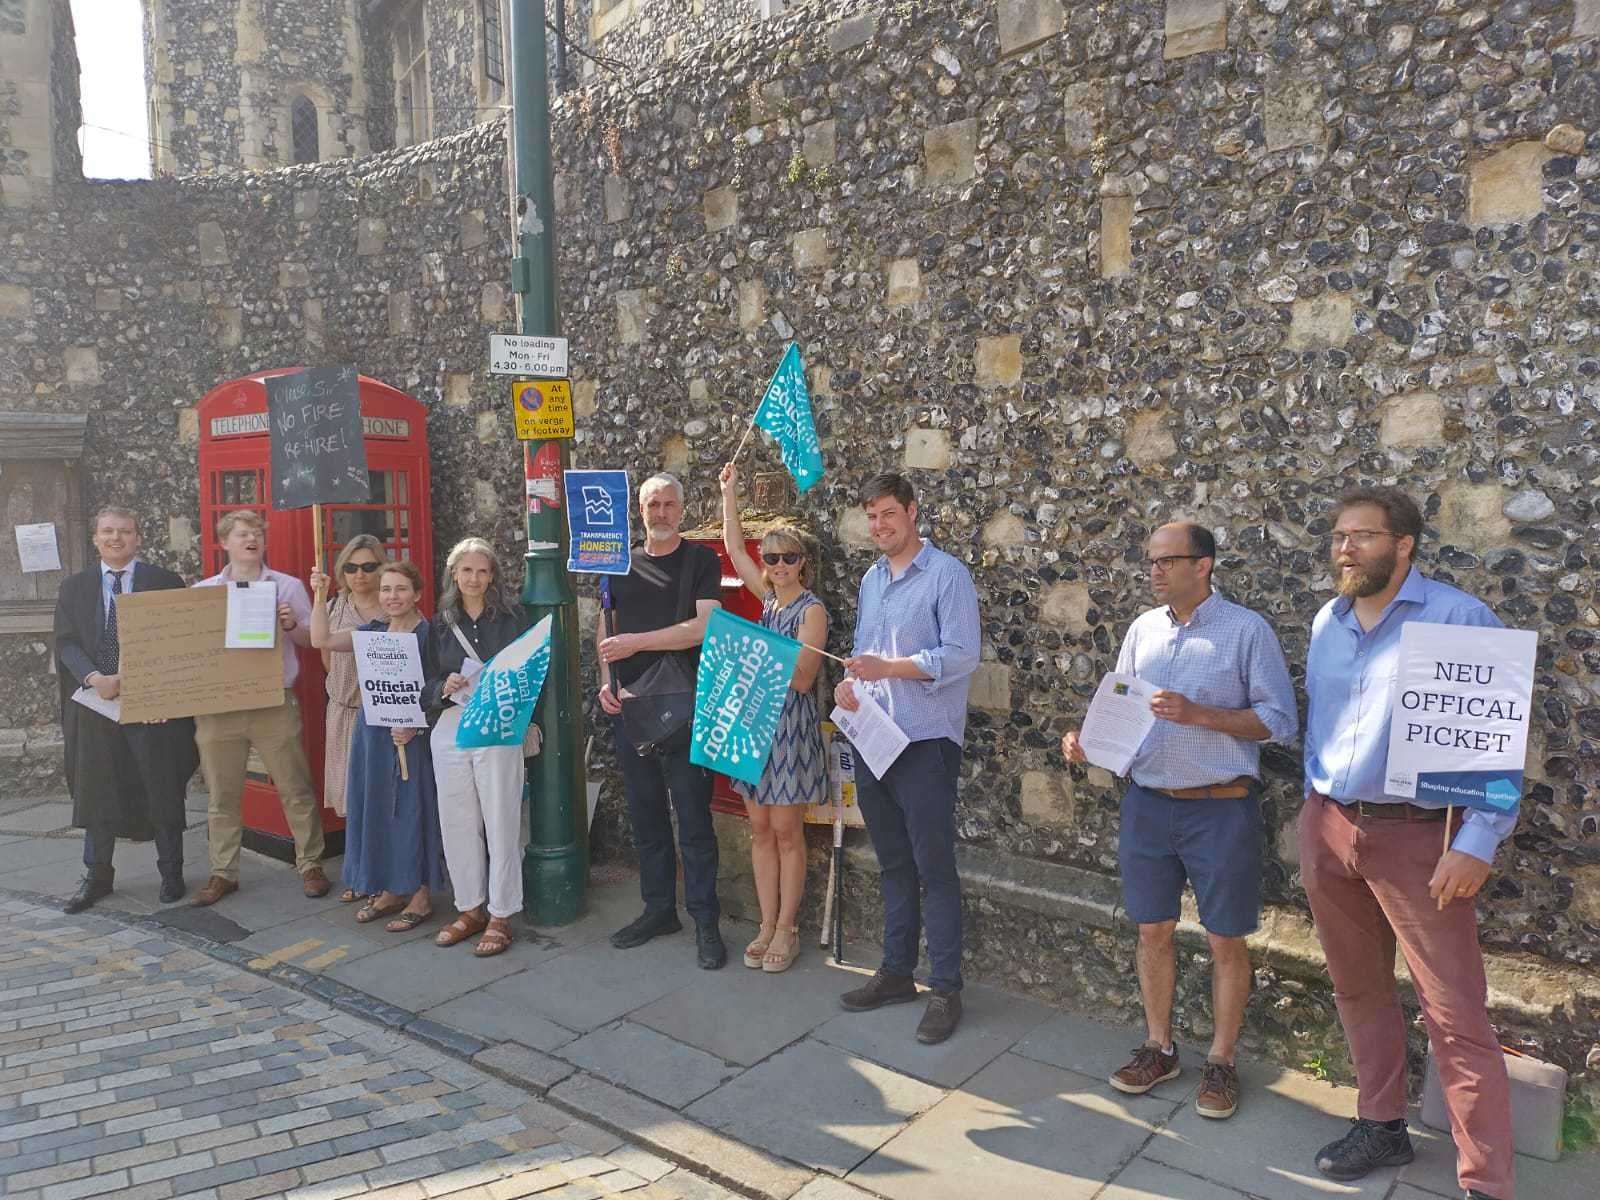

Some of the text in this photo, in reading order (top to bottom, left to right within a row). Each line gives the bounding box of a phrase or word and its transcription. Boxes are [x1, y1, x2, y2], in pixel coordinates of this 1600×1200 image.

[504, 338, 555, 351] No loading
[509, 351, 530, 360] Mon
[537, 353, 550, 361] Fri
[494, 361, 517, 370] 4.30
[551, 385, 562, 393] At
[549, 396, 565, 404] any
[548, 404, 568, 412] time
[212, 415, 270, 435] TELEPHON
[277, 411, 295, 437] NO
[302, 402, 344, 424] FIRE
[538, 418, 564, 426] verge
[533, 426, 570, 435] footway
[579, 541, 623, 553] HONESTY
[1434, 661, 1495, 685] NEU
[364, 679, 421, 692] Official
[371, 693, 417, 706] picket
[1401, 690, 1522, 721] OFFICAL
[1405, 723, 1511, 753] PICKET
[1450, 786, 1485, 797] education
